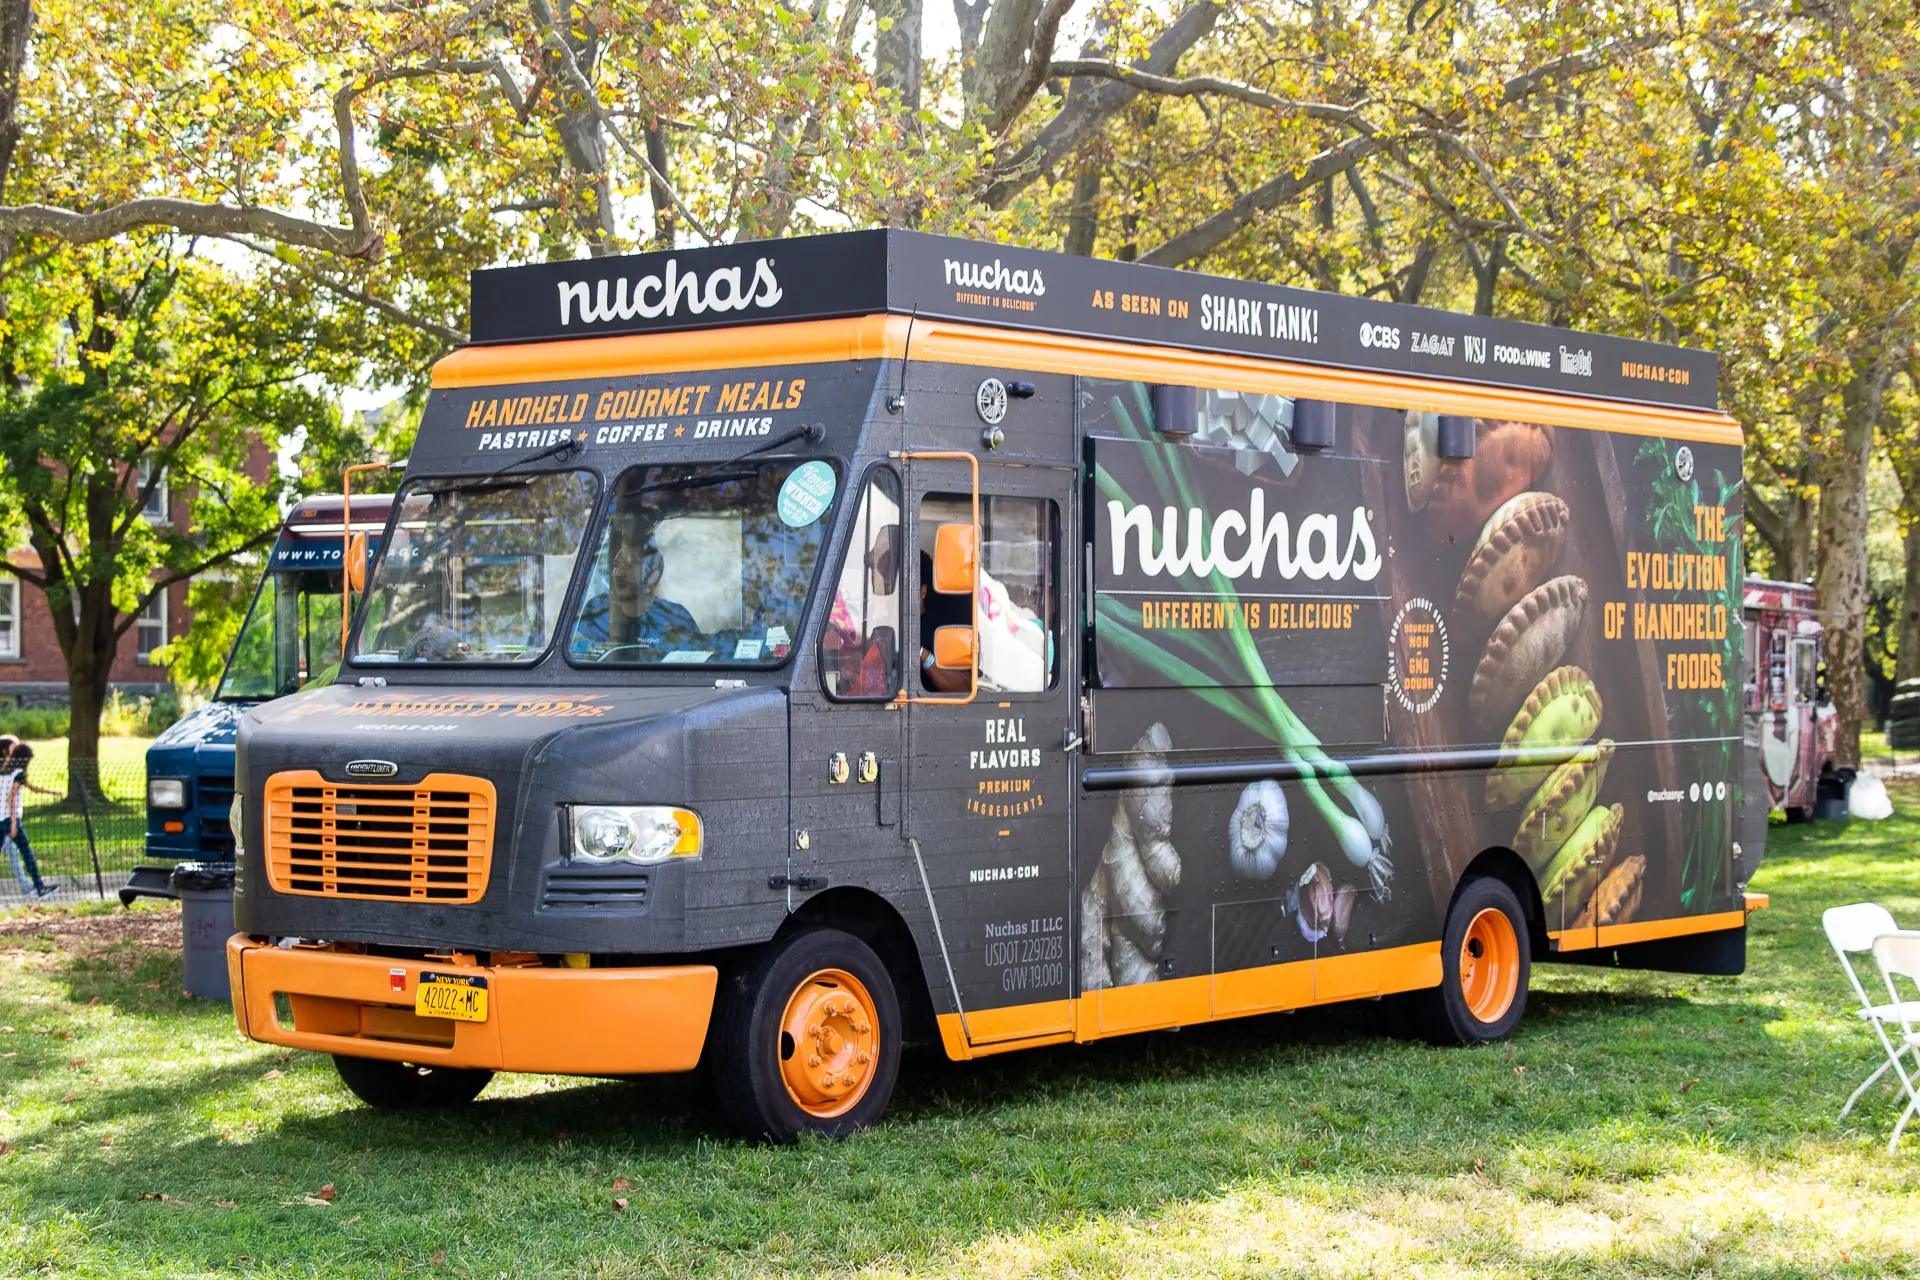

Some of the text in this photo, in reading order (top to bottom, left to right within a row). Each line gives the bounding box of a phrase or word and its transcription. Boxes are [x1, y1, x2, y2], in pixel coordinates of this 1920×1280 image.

[956, 292, 991, 306] DIFFERENT
[993, 297, 1000, 307] IS
[1091, 289, 1319, 344] AS SEEN ON SHARK TANK!
[1372, 324, 1400, 350] CBS
[1410, 332, 1455, 357] ZAGAT
[1463, 335, 1487, 365] WSJ
[465, 379, 806, 429] HANDHELD GOURMET MEALS
[478, 417, 773, 450] PASTRIES COFFEE DRINKS
[785, 480, 823, 515] WINNER
[1693, 505, 1726, 543] THE
[1626, 551, 1726, 592] EVOLUTION
[1142, 602, 1236, 629] DIFFERENT
[1244, 602, 1260, 629] IS
[1603, 602, 1727, 641] OF HANDHELD
[1409, 636, 1429, 648] NON
[1409, 658, 1429, 674] GMO
[1667, 653, 1727, 690] FOODS.
[1404, 677, 1434, 690] DOUGH
[985, 718, 1027, 744] REAL
[970, 748, 1041, 770] FLAVORS
[979, 779, 1031, 794] PREMIUM
[967, 794, 1044, 818] INGREDIENTS
[985, 920, 1028, 938] Nuchas
[1042, 916, 1063, 932] LLC
[985, 935, 1063, 967] USDOT 2297283
[435, 975, 452, 985] NEW
[1002, 966, 1028, 992] GVW
